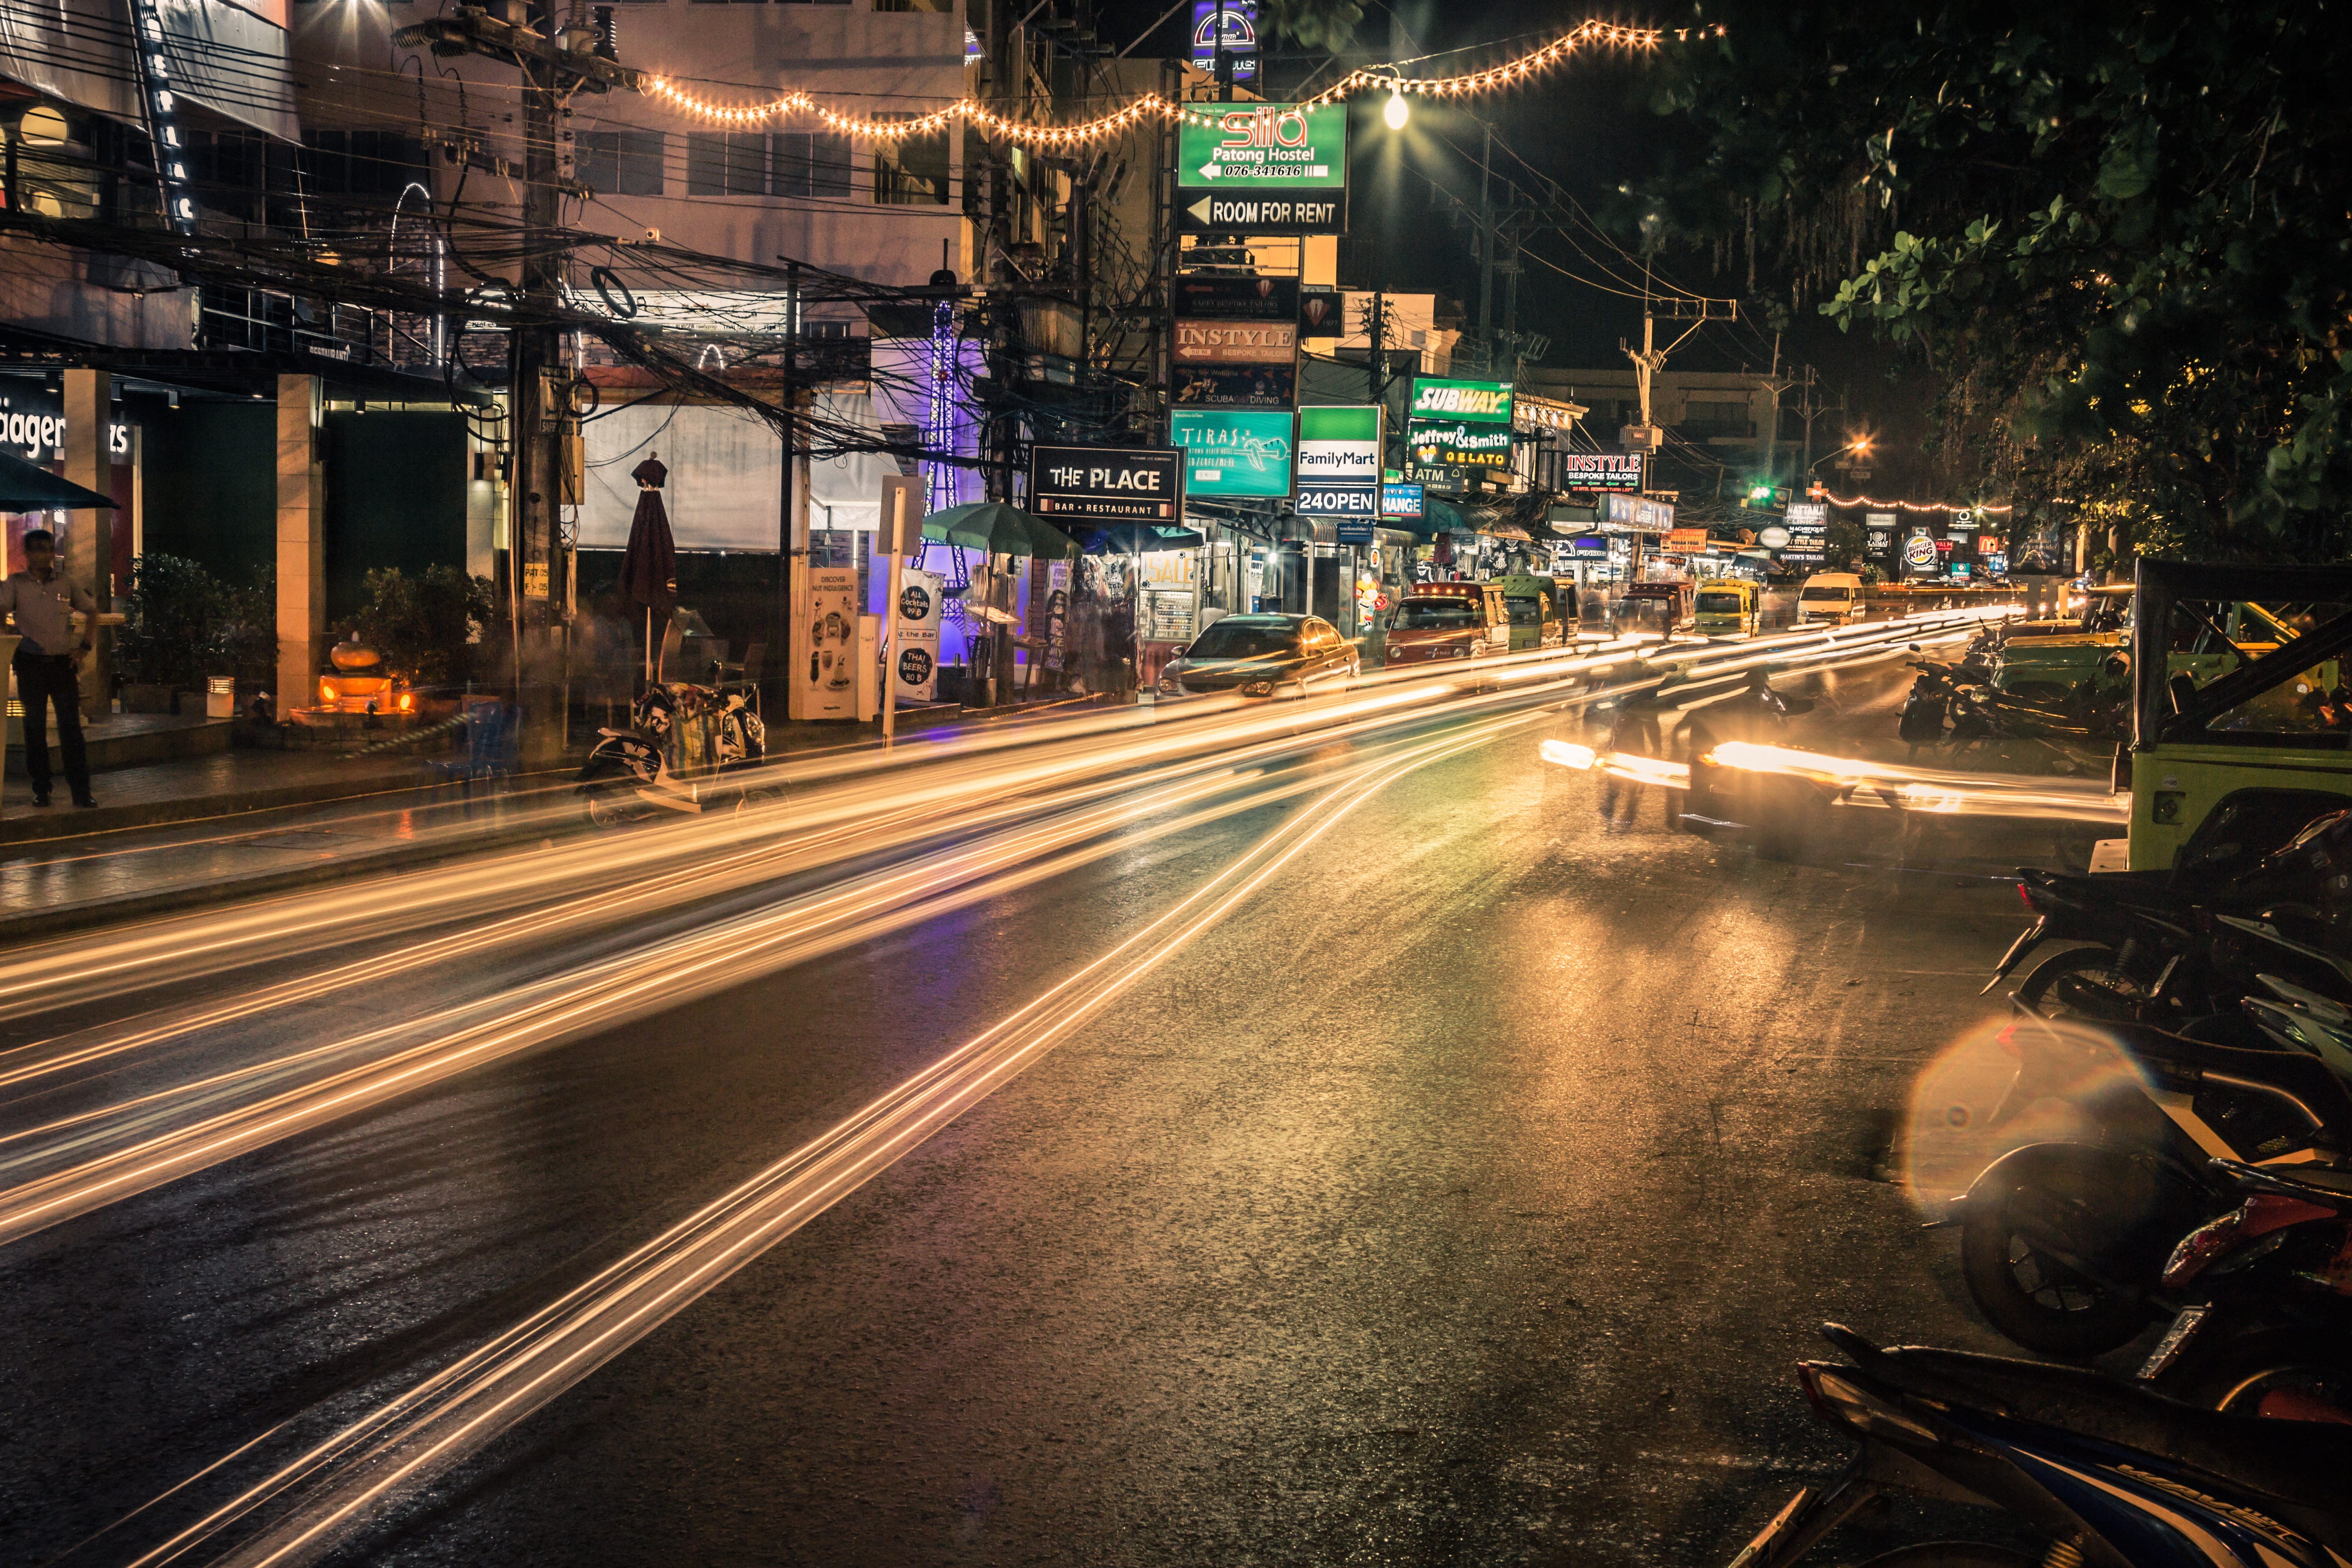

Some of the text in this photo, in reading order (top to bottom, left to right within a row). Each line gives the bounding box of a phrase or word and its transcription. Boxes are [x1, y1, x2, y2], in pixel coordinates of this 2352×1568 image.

[1213, 147, 1314, 164] Patong Hostel
[1225, 165, 1301, 177] 076-341616
[1214, 201, 1335, 223] ROOM FOR RENT
[1178, 328, 1292, 347] INSTYLE
[309, 346, 347, 361] RESTAURANT
[1205, 395, 1234, 403] SCUBA
[1250, 396, 1279, 404] DIVING
[1415, 387, 1509, 413] SUBWAY
[1181, 428, 1237, 446] TIRAS
[1411, 426, 1508, 448] Jeffrey & Smith
[1300, 452, 1375, 467] FamilyMart
[1446, 451, 1504, 465] GELATO
[1567, 455, 1641, 472] INSTYLE
[1050, 467, 1160, 490] THE PLACE
[1415, 468, 1444, 481] ATM
[1087, 504, 1152, 514] RESTAURANT
[1383, 498, 1420, 512] HANGE
[1908, 542, 1932, 553] BURGER
[1909, 547, 1933, 560] KING
[525, 568, 539, 577] PAT
[1148, 558, 1194, 583] SALE
[901, 598, 929, 608] Cocktails
[907, 652, 925, 661] THAI
[903, 662, 927, 673] BEERS
